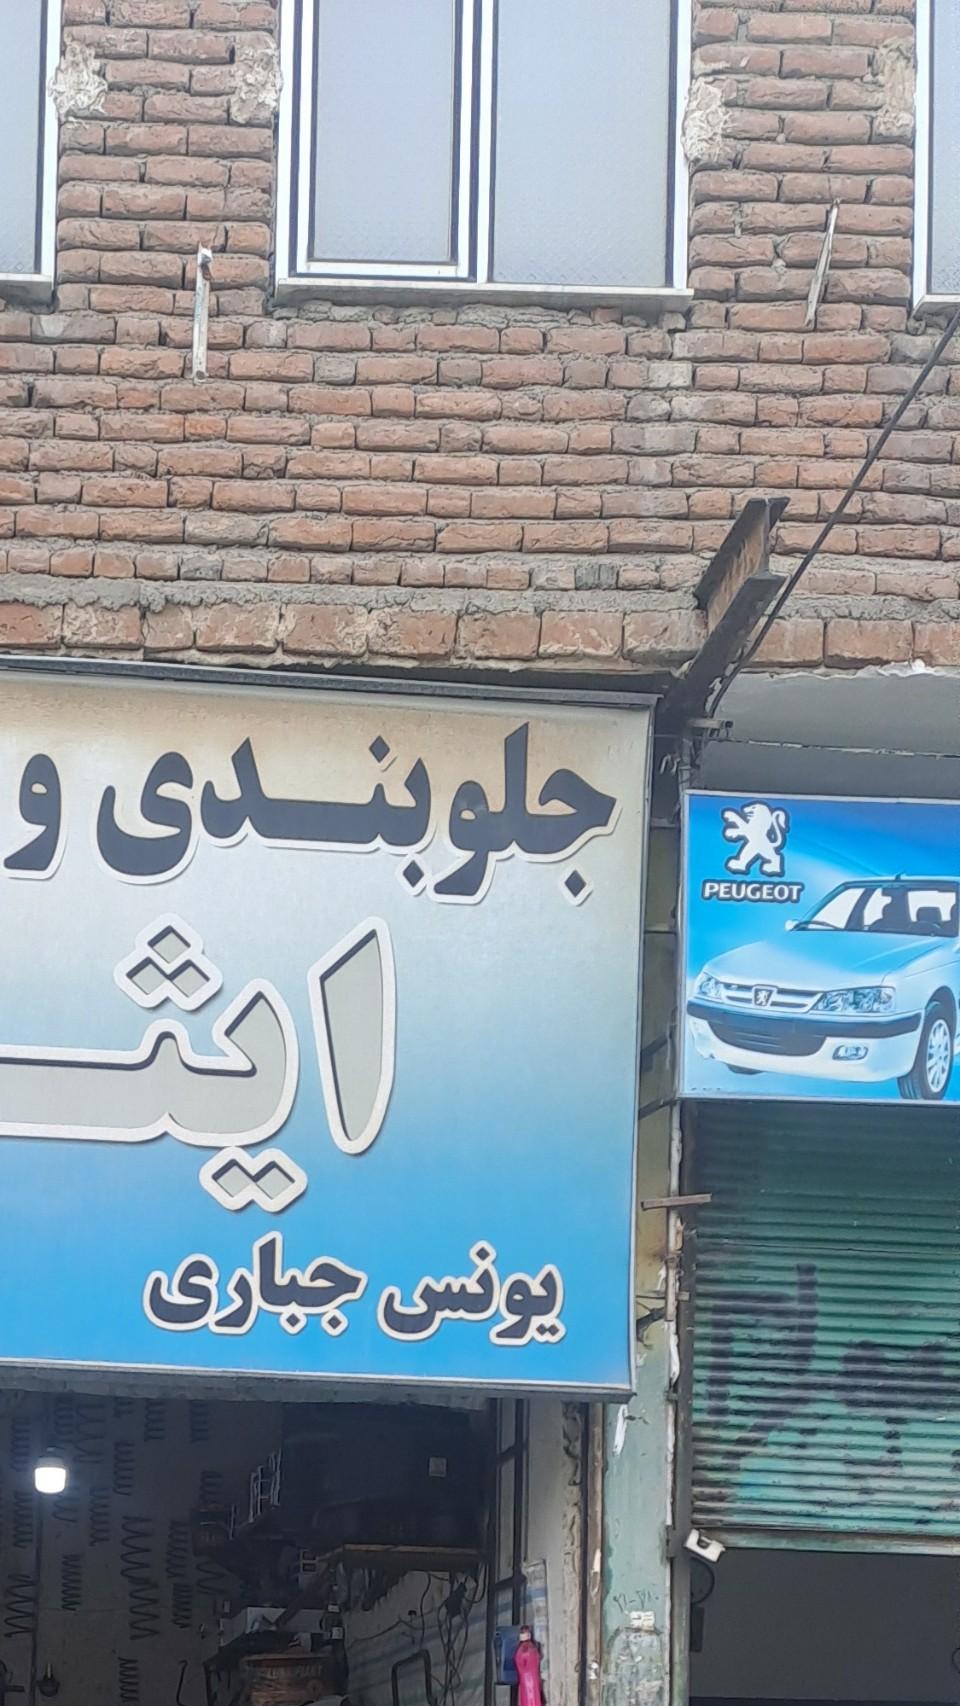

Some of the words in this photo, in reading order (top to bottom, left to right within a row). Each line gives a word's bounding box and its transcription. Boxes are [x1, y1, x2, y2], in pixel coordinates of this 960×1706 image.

[2, 752, 64, 873] و
[96, 719, 619, 900] جلوبندی
[702, 881, 804, 902] PEUGEOT
[146, 1233, 364, 1334] جباری
[381, 1241, 564, 1343] یونس
